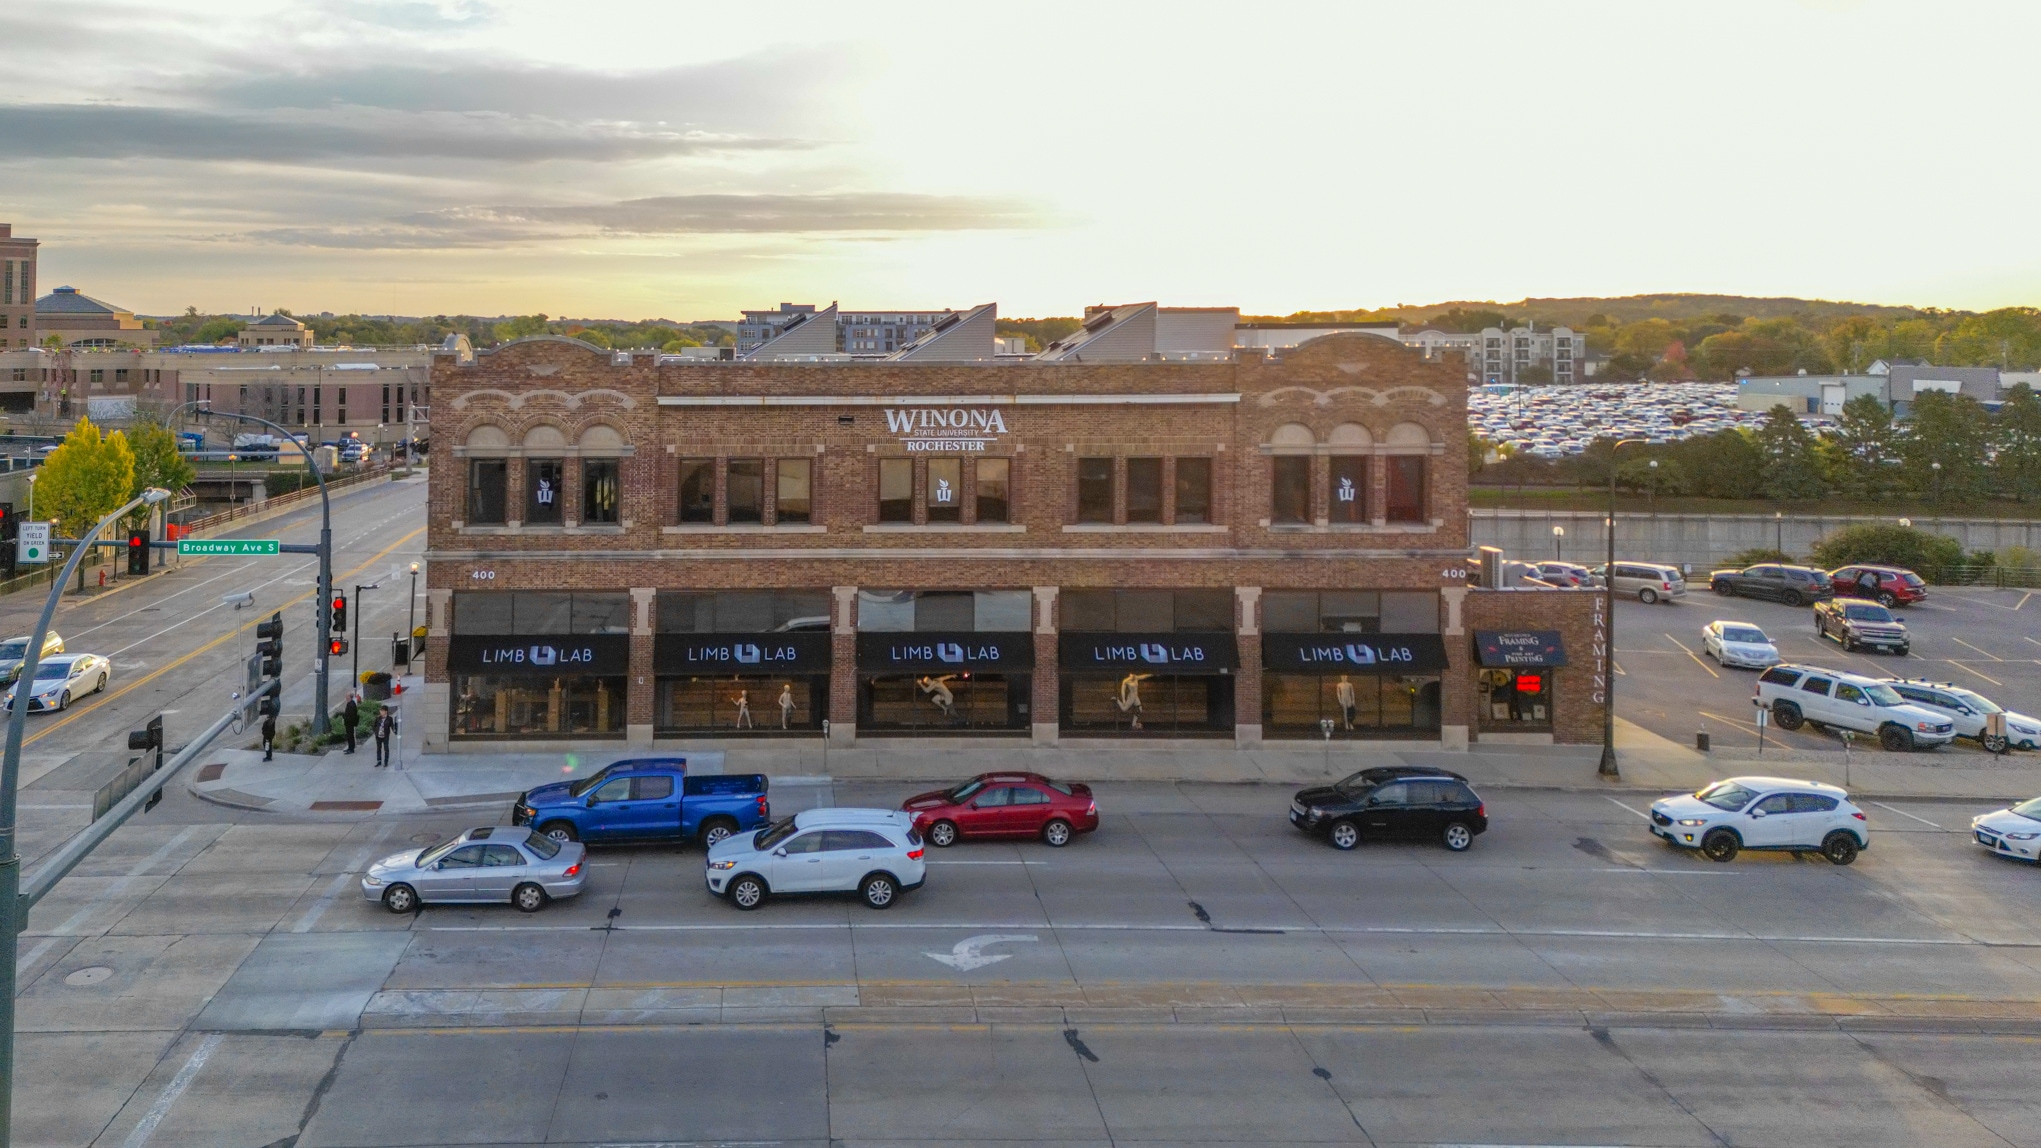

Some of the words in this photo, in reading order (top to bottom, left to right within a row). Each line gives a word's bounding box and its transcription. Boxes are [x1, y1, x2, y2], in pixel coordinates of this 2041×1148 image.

[884, 409, 1008, 433] WINONA
[937, 429, 980, 437] UNIVERSITY
[907, 441, 985, 451] ROCHESTER
[183, 543, 236, 553] Broadway
[242, 543, 262, 552] Ave
[268, 543, 275, 552] S
[472, 571, 495, 580] 400
[1442, 569, 1466, 578] 400
[1498, 635, 1539, 645] FRAMING
[482, 649, 525, 663] LIMB
[559, 648, 592, 662] LAB
[688, 647, 730, 661] LIMB
[764, 646, 797, 660] LAB
[892, 646, 933, 660] LIMB
[967, 646, 1000, 660] LAB
[1094, 646, 1137, 660] LIMB
[1171, 646, 1205, 660] LAB
[1300, 647, 1344, 661] LIMB
[1379, 647, 1413, 661] LAB
[1592, 597, 1606, 704] FRAMING
[1504, 654, 1543, 662] PRINTING
